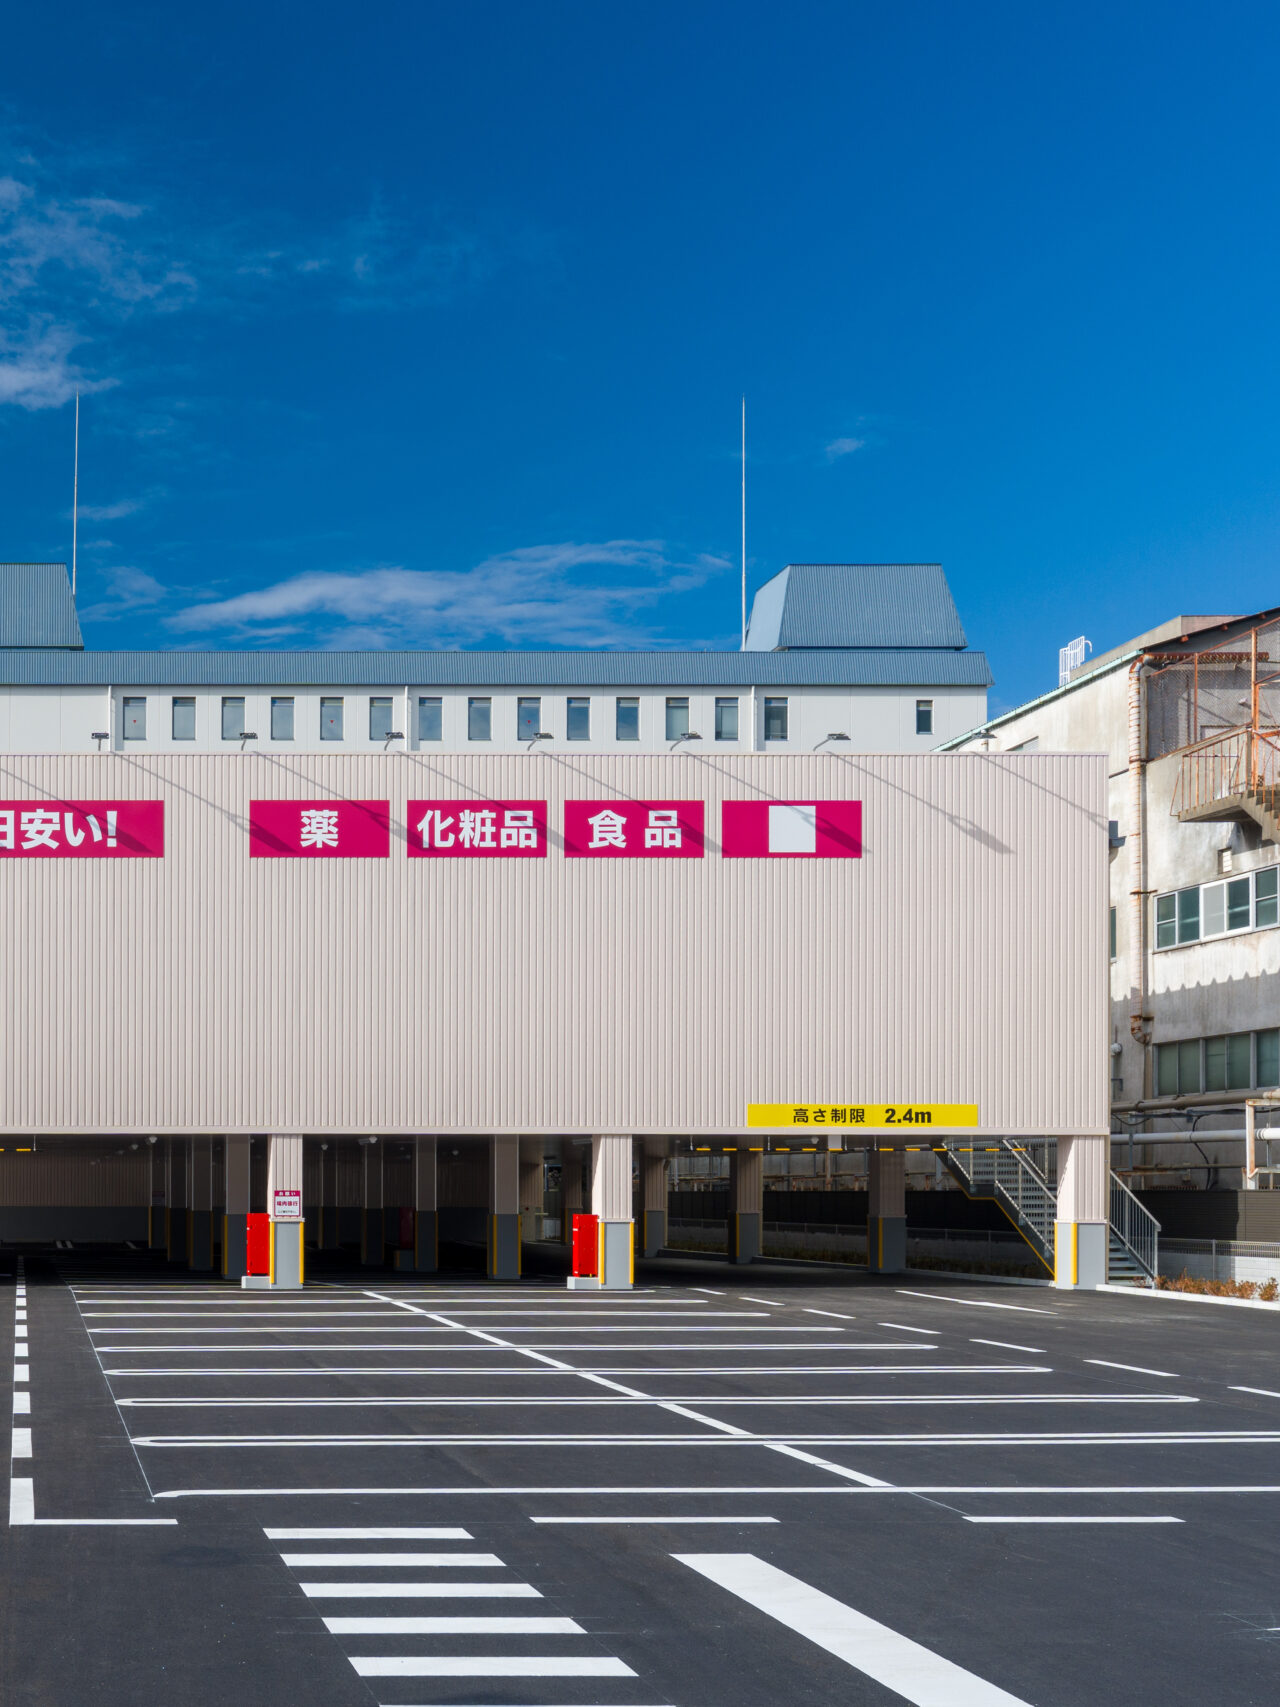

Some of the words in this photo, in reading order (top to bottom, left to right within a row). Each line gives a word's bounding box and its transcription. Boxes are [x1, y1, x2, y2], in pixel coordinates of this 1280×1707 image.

[299, 808, 339, 849] 薬
[416, 808, 538, 849] 化粧品
[793, 1108, 865, 1123] 高さ制限
[884, 1108, 932, 1123] 2.4m
